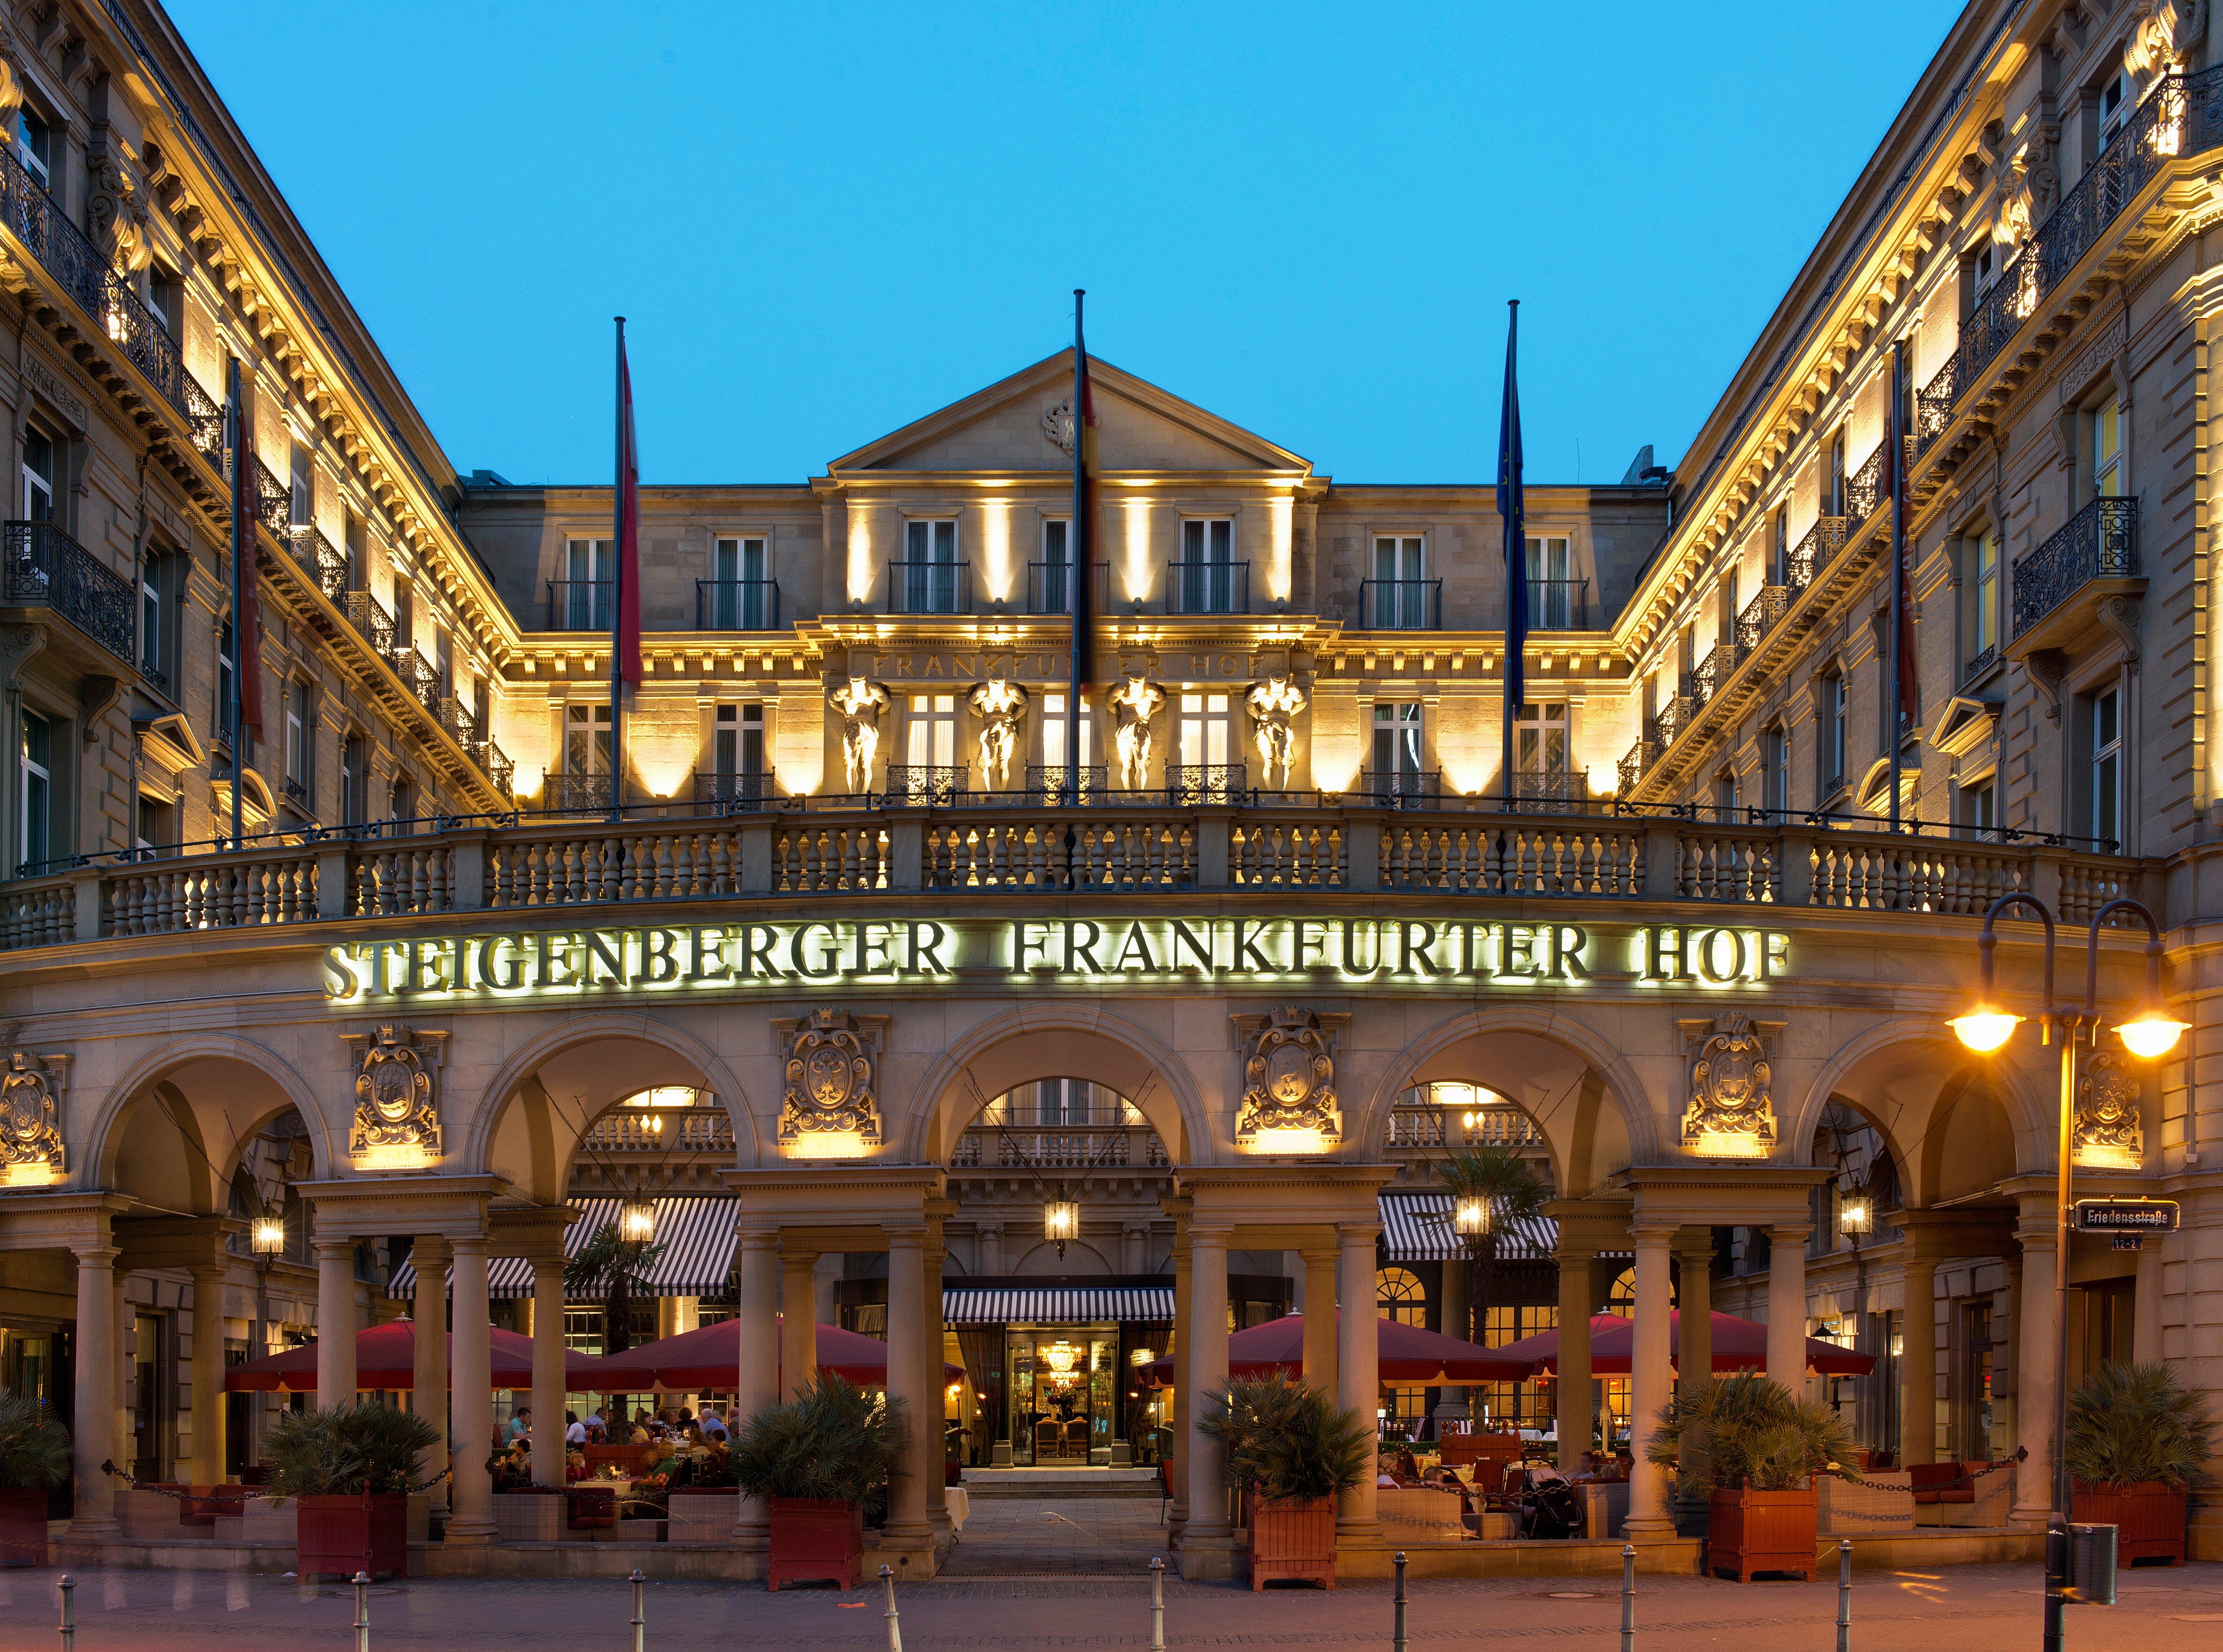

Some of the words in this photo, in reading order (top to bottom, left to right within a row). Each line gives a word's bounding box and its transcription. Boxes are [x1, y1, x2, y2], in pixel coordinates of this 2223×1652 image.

[873, 654, 1166, 677] FRANKFUTER
[1191, 654, 1264, 677] HOF
[323, 920, 952, 1000] STEIGENBERGER
[1008, 919, 1592, 980] FRANKFURTER
[1639, 926, 1792, 983] HOF
[2088, 1210, 2168, 1226] Friedensstraße
[2115, 1239, 2136, 1248] 12-2
